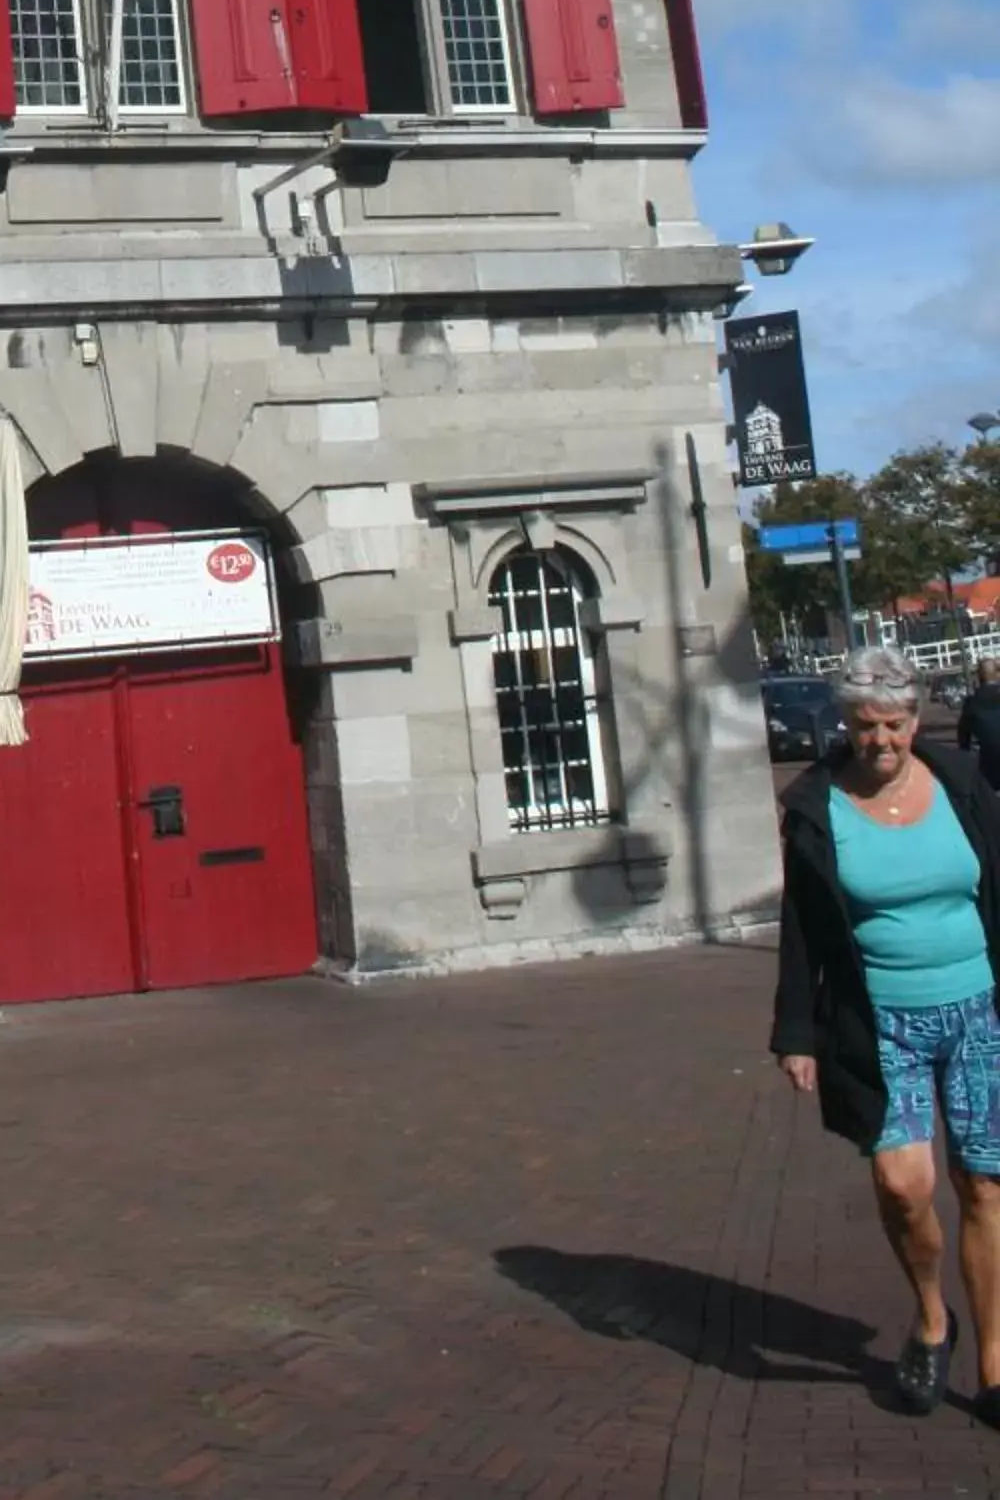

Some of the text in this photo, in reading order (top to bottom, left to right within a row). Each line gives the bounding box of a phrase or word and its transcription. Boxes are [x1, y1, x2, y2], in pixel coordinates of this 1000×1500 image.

[745, 466, 765, 479] DE
[768, 459, 812, 476] WAAG
[60, 618, 85, 634] DE
[91, 613, 150, 630] WAAG
